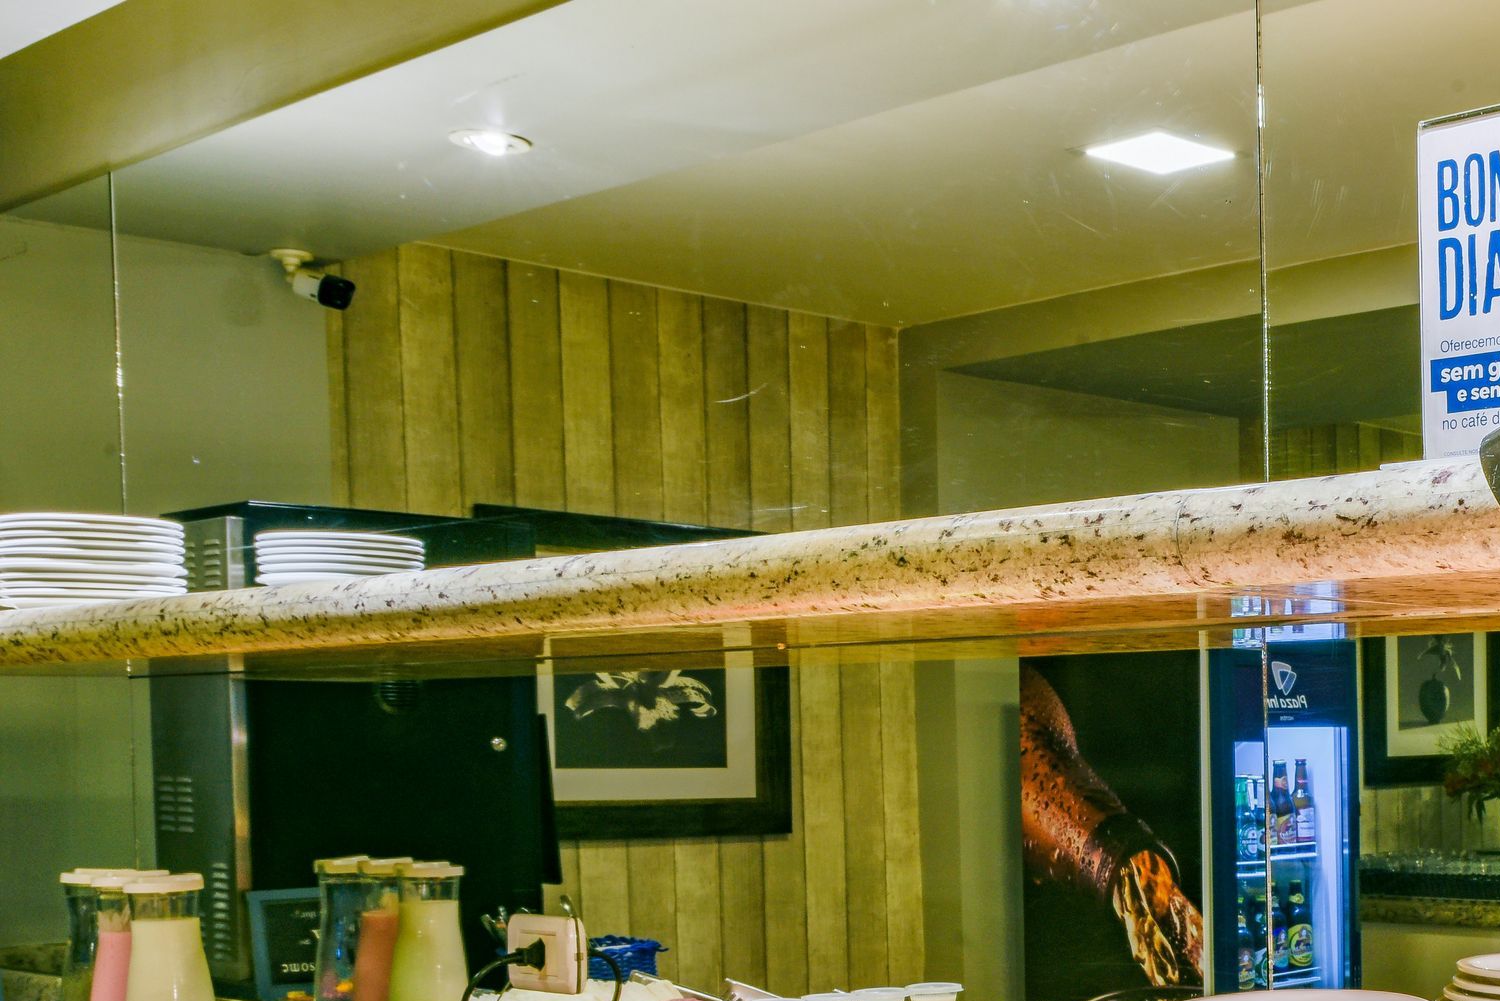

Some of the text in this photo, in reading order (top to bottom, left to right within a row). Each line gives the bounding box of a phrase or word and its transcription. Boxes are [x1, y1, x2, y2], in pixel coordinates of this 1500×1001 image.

[1440, 363, 1484, 383] sem
[1457, 389, 1468, 401] e
[1442, 419, 1458, 430] no
[1461, 412, 1488, 428] café
